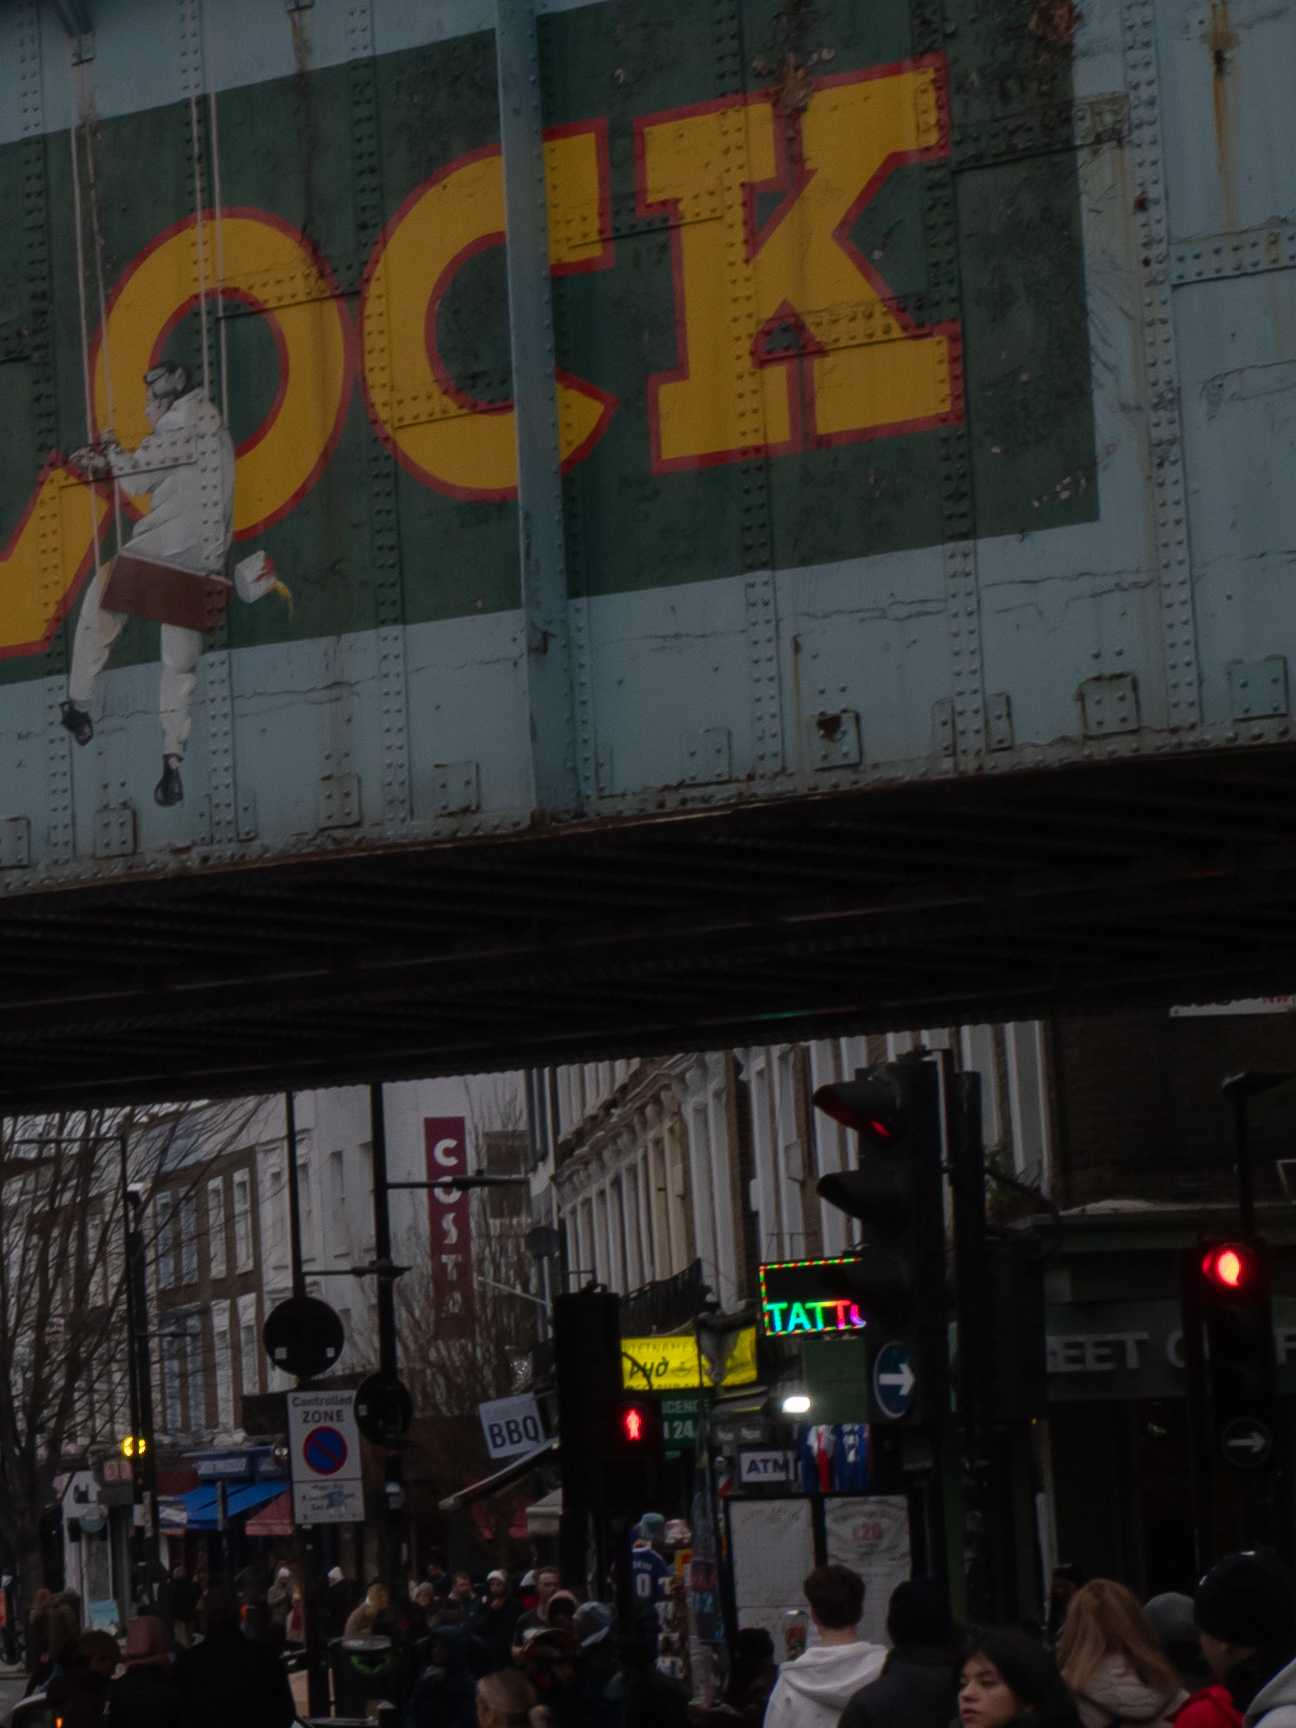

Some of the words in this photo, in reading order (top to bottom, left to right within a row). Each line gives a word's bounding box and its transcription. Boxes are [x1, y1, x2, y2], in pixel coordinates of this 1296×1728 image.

[291, 1395, 353, 1408] Controlled
[302, 1409, 346, 1424] ZONE
[488, 1415, 543, 1449] BBQ
[747, 1459, 789, 1474] ATM
